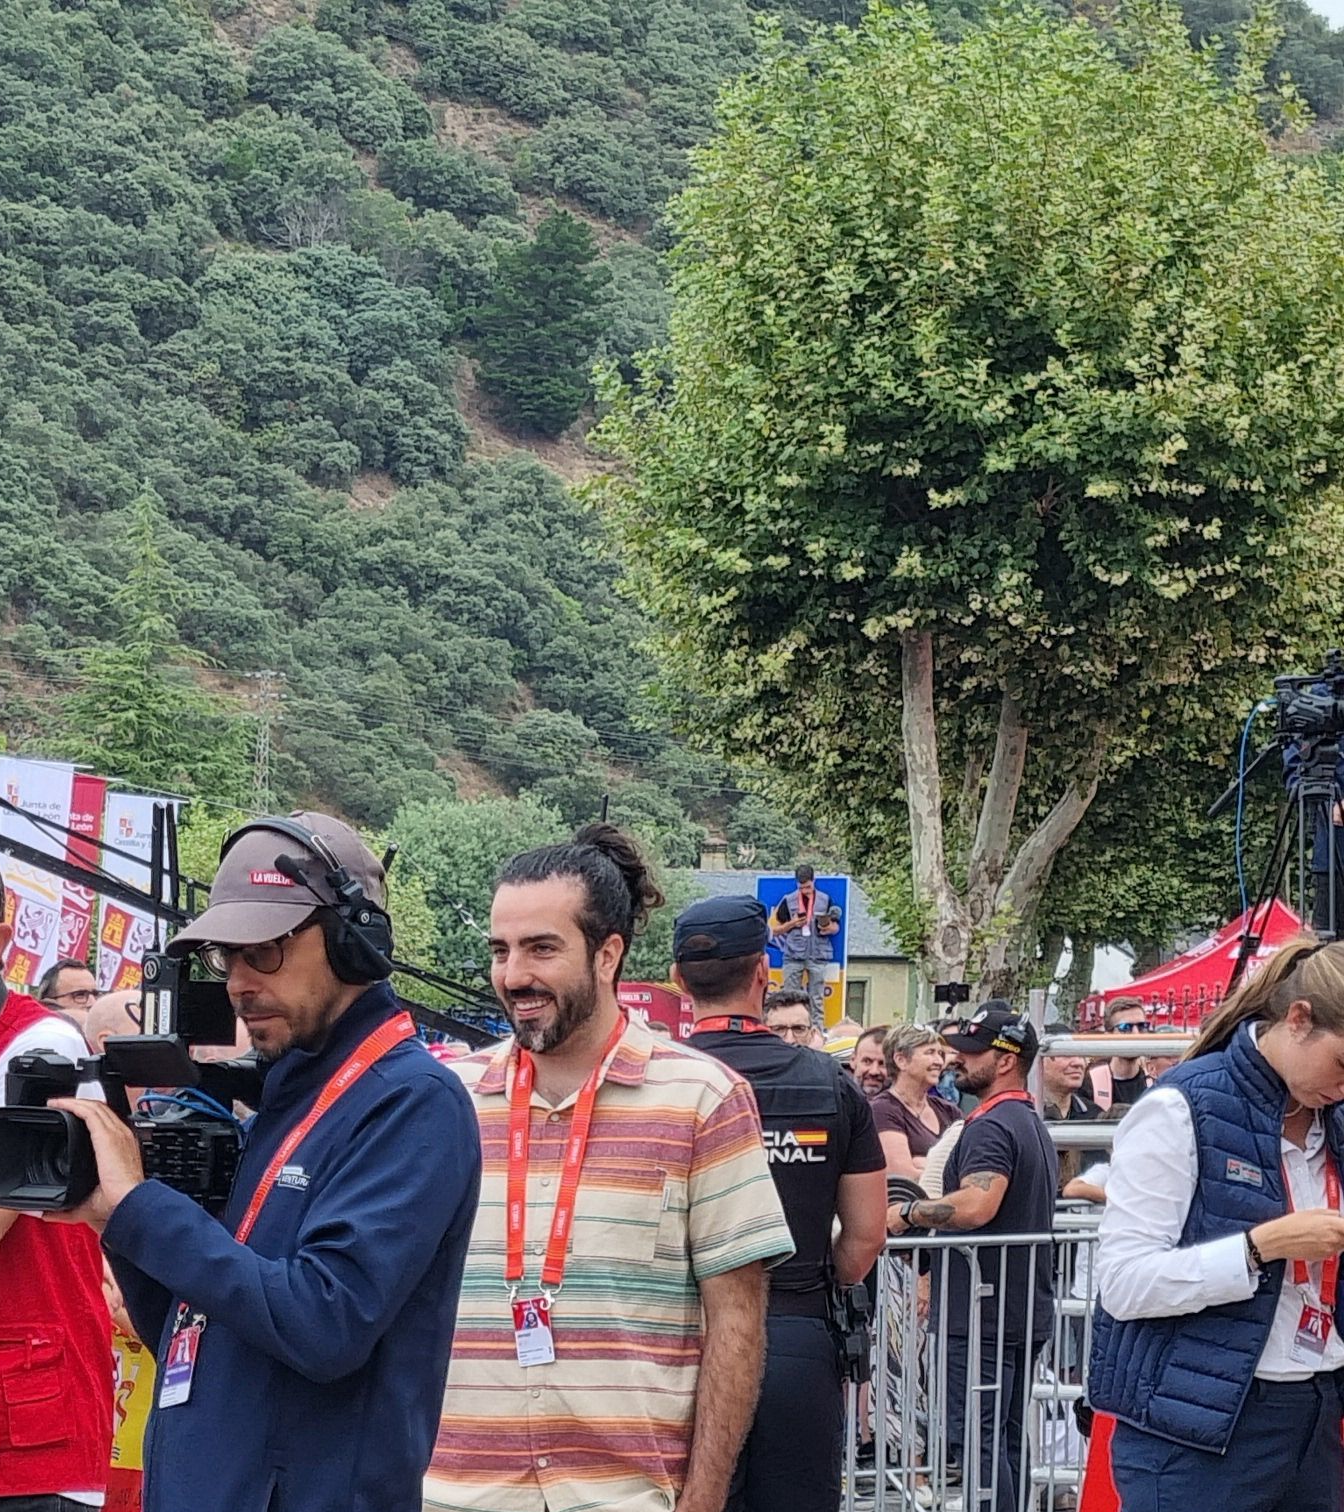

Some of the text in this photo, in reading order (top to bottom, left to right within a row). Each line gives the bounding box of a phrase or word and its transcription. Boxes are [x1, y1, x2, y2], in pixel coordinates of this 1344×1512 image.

[21, 801, 62, 811] Junta de
[82, 812, 94, 822] de
[253, 872, 263, 883] LA
[992, 1039, 1021, 1053] JUMBO
